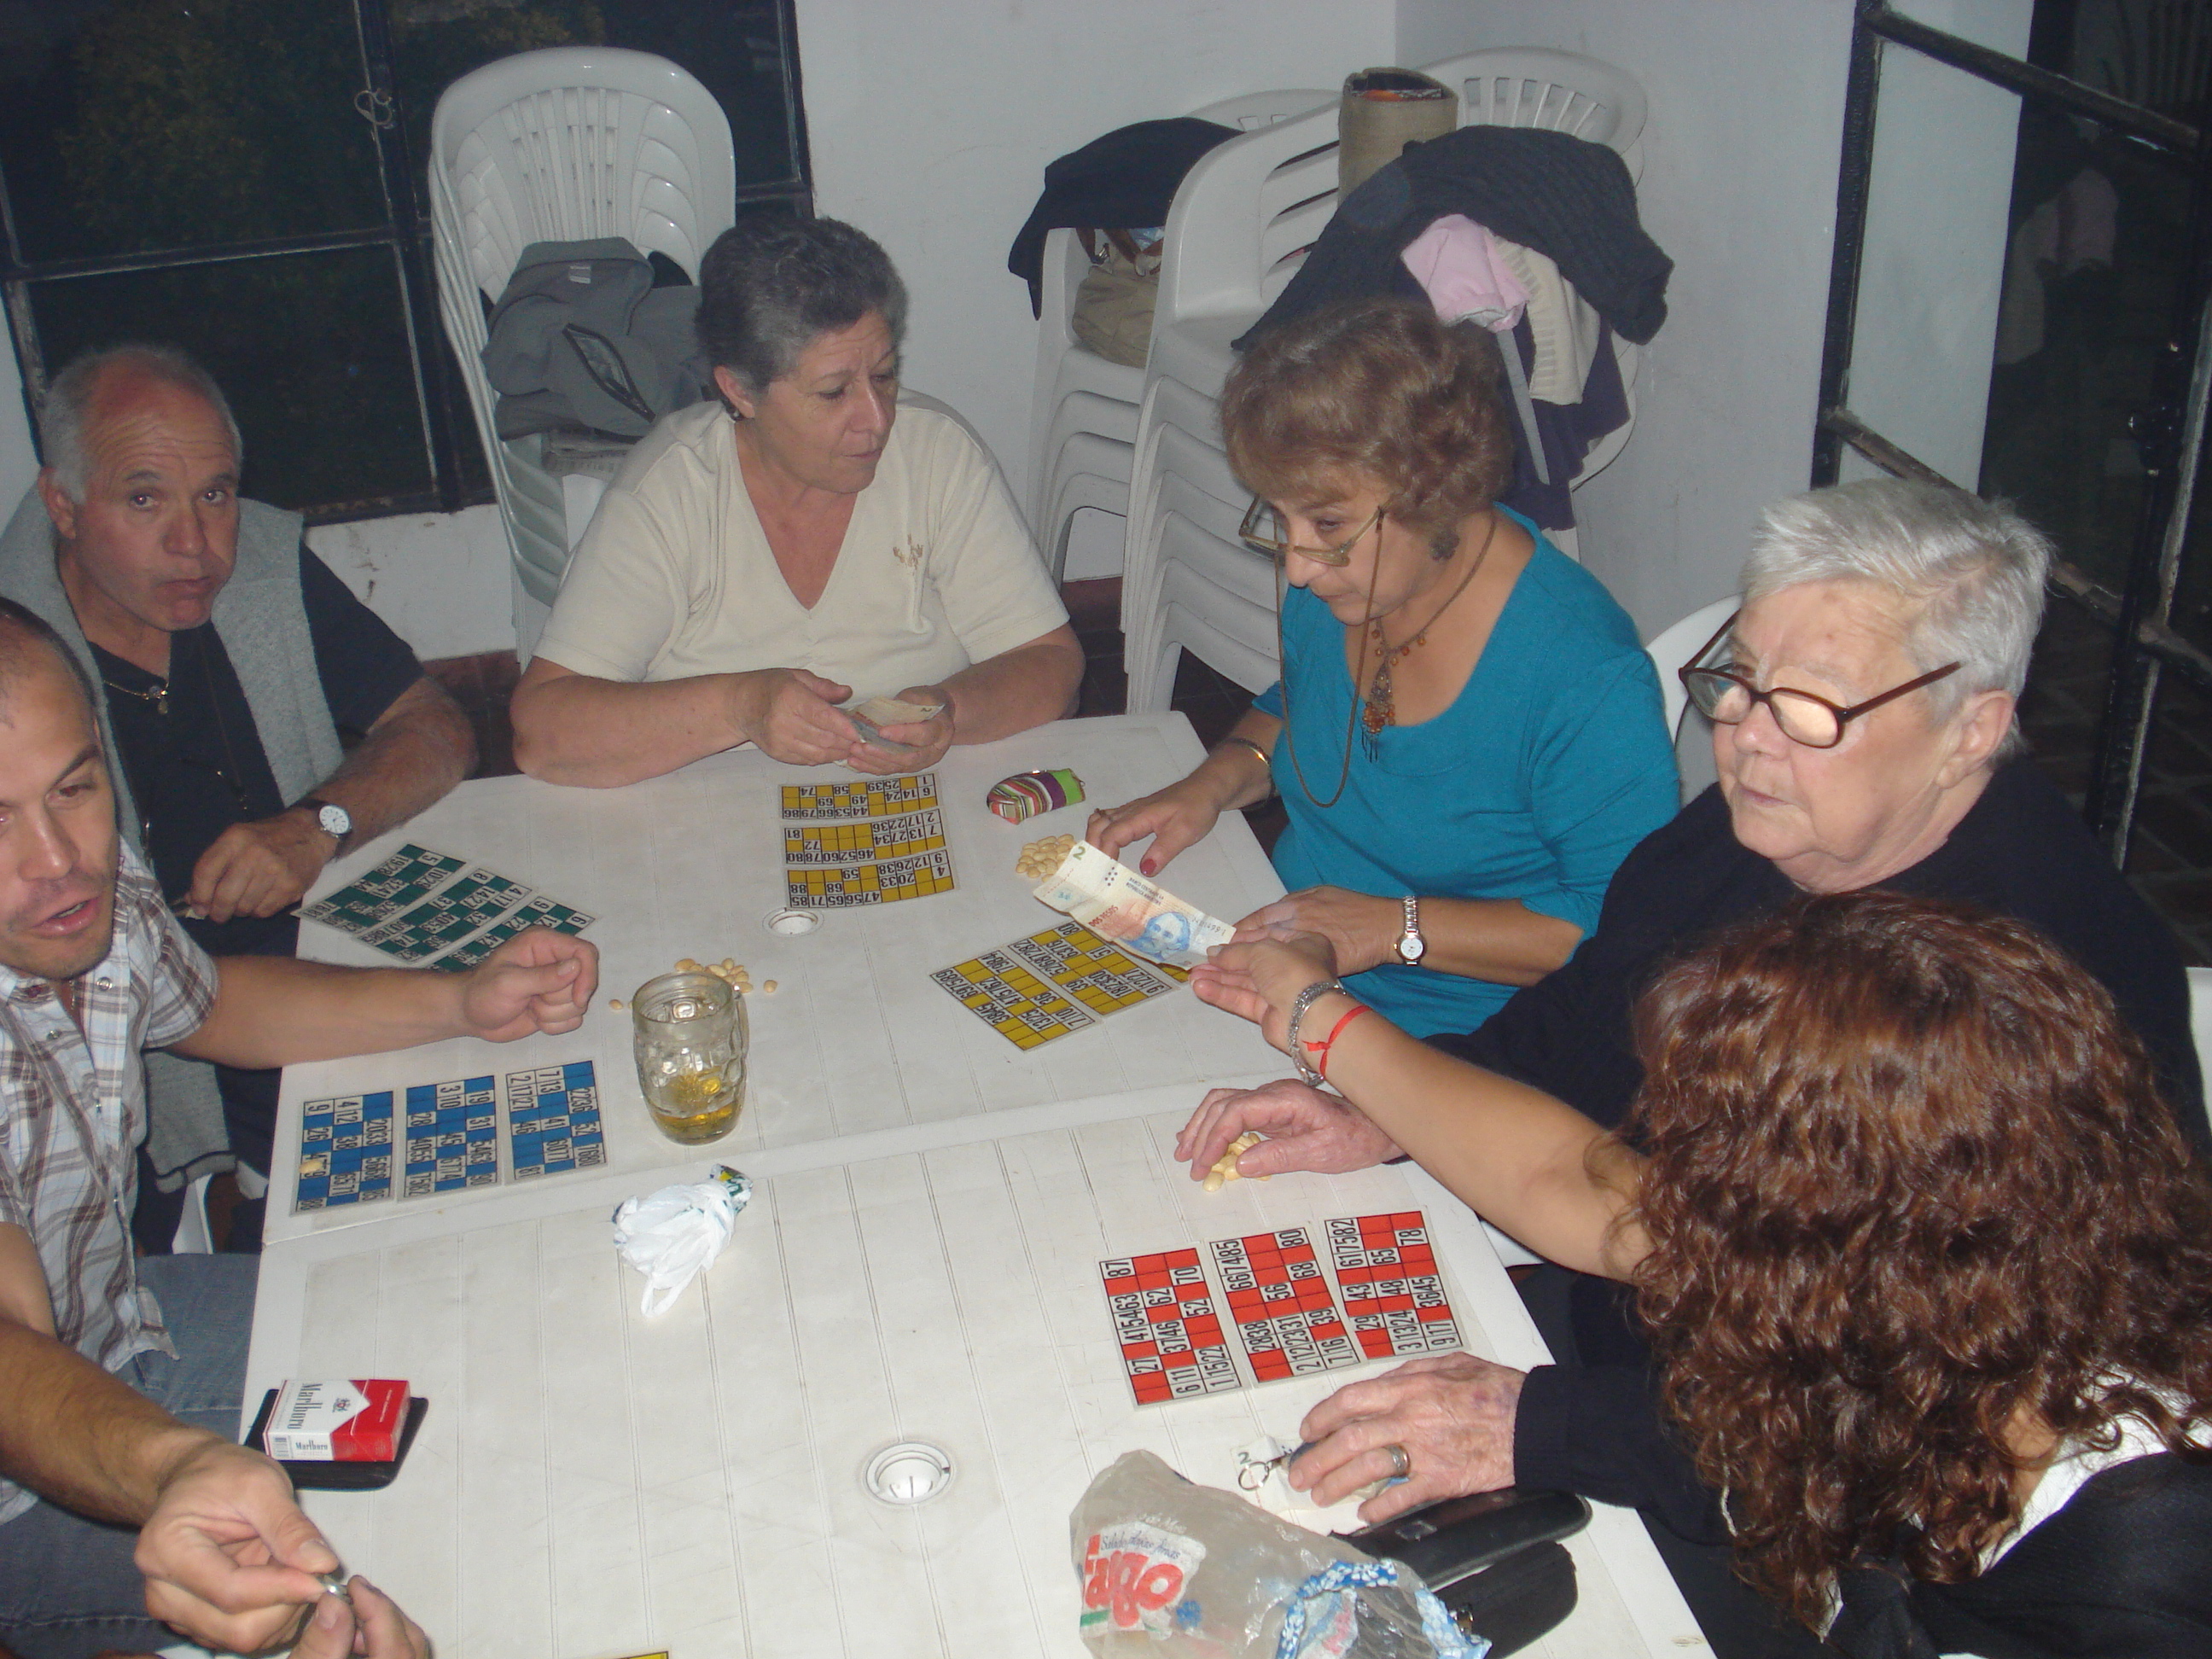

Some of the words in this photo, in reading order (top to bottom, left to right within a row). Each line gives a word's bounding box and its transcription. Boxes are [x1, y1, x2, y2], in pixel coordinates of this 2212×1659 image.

[882, 779, 899, 792] 25
[923, 776, 928, 785] 1
[799, 786, 817, 797] 74
[832, 784, 850, 796] 58
[865, 782, 883, 794] 39
[903, 789, 917, 800] 14
[923, 787, 931, 796] 6
[818, 797, 835, 806] 69
[851, 795, 868, 805] 49
[884, 790, 901, 803] 24
[783, 809, 800, 819] 86
[800, 809, 817, 819] 79
[834, 807, 852, 818] 53
[927, 812, 935, 823] 2
[888, 818, 905, 833] 22
[908, 815, 921, 827] 17
[787, 830, 800, 839] 81
[870, 822, 888, 835] 36
[909, 828, 923, 840] 13
[930, 824, 937, 835] 7
[874, 834, 891, 846] 34
[890, 830, 907, 845] 27
[802, 841, 820, 853] 72
[1073, 846, 1086, 860] 2
[786, 853, 804, 864] 80
[803, 853, 821, 864] 78
[839, 850, 857, 862] 52
[914, 856, 928, 869] 12
[934, 853, 943, 864] 9
[876, 863, 895, 877] 38
[894, 859, 912, 875] 26
[937, 866, 946, 876] 4
[841, 867, 860, 882] 59
[896, 871, 916, 887] 20
[826, 882, 844, 894] 68
[878, 876, 897, 889] 33
[789, 884, 807, 896] 88
[790, 896, 809, 908] 85
[811, 896, 825, 906] 71
[844, 893, 864, 906] 56
[1057, 923, 1085, 936] 80
[1013, 939, 1036, 953] 82
[1045, 939, 1068, 953] 76
[1055, 946, 1079, 960] 63
[1089, 946, 1111, 959] 51
[981, 952, 1006, 967] 84
[1023, 946, 1046, 962] 72
[991, 959, 1015, 975] 79
[1033, 954, 1057, 969] 68
[1086, 969, 1112, 983] 30
[1118, 969, 1149, 981] 27
[1132, 975, 1155, 989] 12
[975, 975, 1003, 991] 62
[1065, 978, 1090, 992] 39
[1097, 976, 1125, 990] 23
[986, 986, 1013, 999] 57
[1110, 985, 1132, 997] 18
[997, 993, 1027, 1005] 47
[1033, 992, 1061, 1006] 36
[1017, 1008, 1046, 1022] 25
[1052, 1007, 1078, 1020] 10
[1032, 1017, 1055, 1030] 13
[1067, 1017, 1087, 1027] 7
[509, 1075, 532, 1085] 2
[540, 1080, 562, 1094] 13
[439, 1085, 461, 1093] 3
[511, 1086, 533, 1097] 17
[569, 1086, 592, 1103] 22
[439, 1094, 464, 1111] 10
[468, 1091, 493, 1107] 19
[512, 1096, 539, 1113] 27
[571, 1098, 597, 1115] 36
[336, 1109, 362, 1126] 12
[409, 1111, 436, 1128] 28
[469, 1117, 494, 1132] 31
[306, 1125, 333, 1142] 26
[1326, 1218, 1357, 1236] 82
[1275, 1229, 1309, 1249] 80
[1334, 1235, 1360, 1254] 75
[1398, 1228, 1429, 1248] 78
[1212, 1237, 1243, 1258] 85
[1338, 1253, 1364, 1267] 61
[1370, 1249, 1397, 1266] 65
[1104, 1261, 1132, 1278] 87
[1221, 1255, 1248, 1275] 74
[1289, 1261, 1322, 1280] 68
[1173, 1266, 1204, 1286] 70
[1226, 1272, 1254, 1290] 66
[1379, 1280, 1406, 1295] 48
[1411, 1276, 1437, 1292] 45
[1145, 1288, 1173, 1306] 62
[1262, 1282, 1296, 1302] 56
[1346, 1283, 1372, 1300] 43
[1114, 1294, 1140, 1311] 63
[1414, 1290, 1443, 1309] 36
[1183, 1298, 1214, 1319] 52
[1118, 1309, 1145, 1330] 54
[1276, 1315, 1303, 1330] 31
[1308, 1307, 1341, 1326] 39
[1355, 1313, 1385, 1331] 29
[1388, 1310, 1415, 1326] 24
[1123, 1327, 1149, 1341] 41
[1155, 1320, 1182, 1337] 46
[1241, 1319, 1272, 1338] 38
[1393, 1324, 1419, 1340] 13
[1425, 1323, 1452, 1336] 17
[1246, 1334, 1278, 1353] 28
[1279, 1328, 1310, 1346] 23
[1430, 1336, 1456, 1346] 9
[1157, 1336, 1191, 1355] 37
[1289, 1344, 1316, 1360] 12
[1320, 1338, 1348, 1353] 16
[1397, 1342, 1423, 1351] 3
[1198, 1345, 1226, 1362] 22
[1327, 1355, 1353, 1365] 7
[1131, 1359, 1159, 1373] 27
[1203, 1361, 1231, 1377] 15
[1295, 1360, 1322, 1371] 2
[1170, 1368, 1196, 1382] 11
[1175, 1384, 1201, 1394] 6
[1209, 1378, 1235, 1387] 1
[288, 1383, 323, 1429] Marlboro
[295, 1440, 328, 1451] Marlboro
[1237, 1452, 1251, 1464] 2
